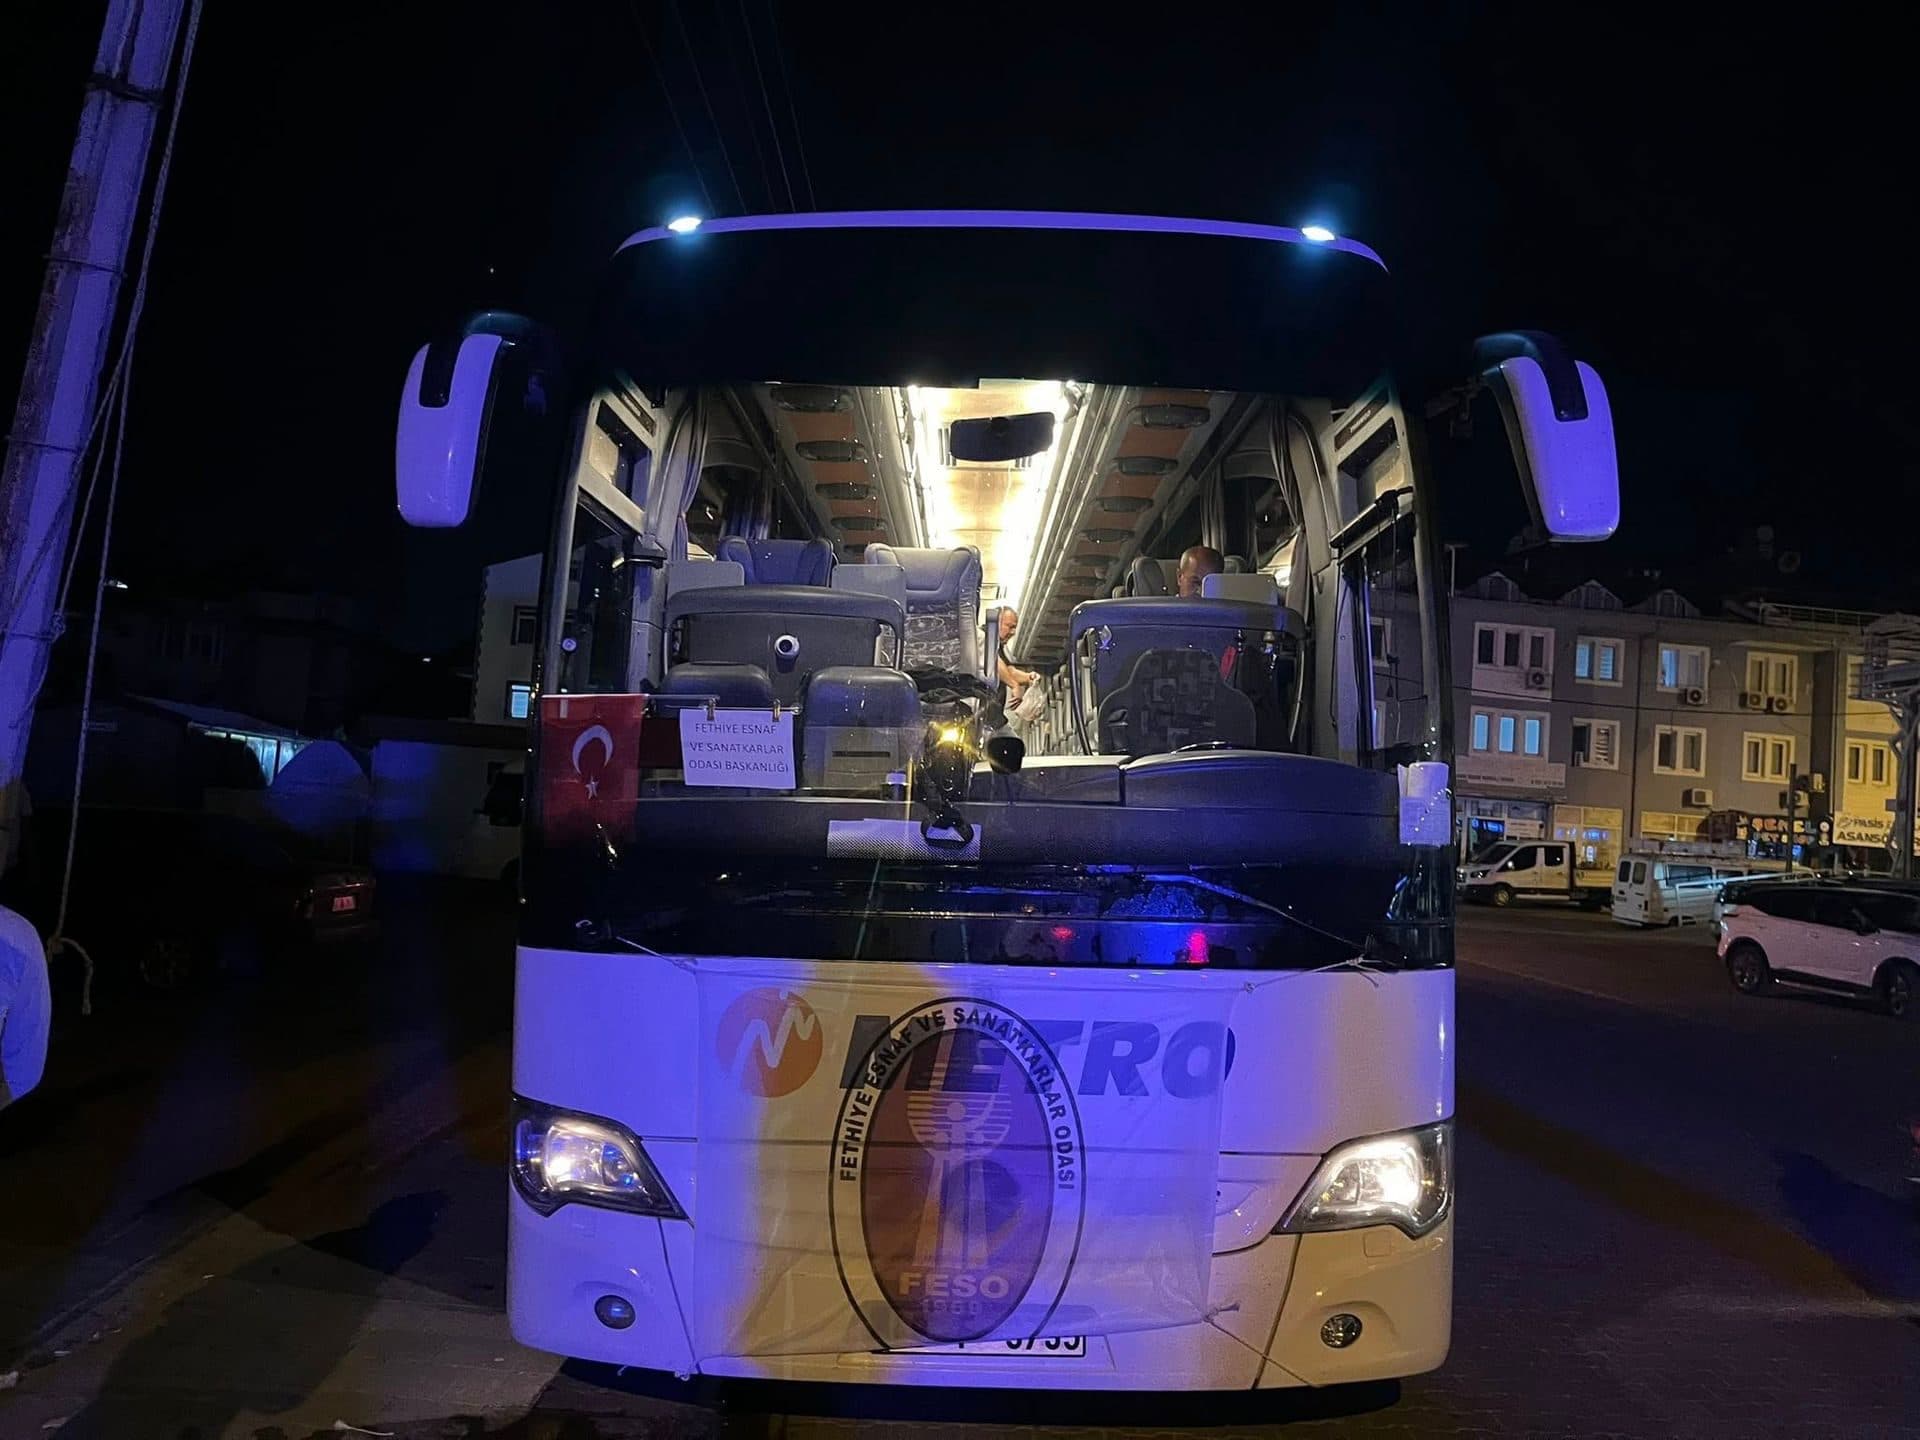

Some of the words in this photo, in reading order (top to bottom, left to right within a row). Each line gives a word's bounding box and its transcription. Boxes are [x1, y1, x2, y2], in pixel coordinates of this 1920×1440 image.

[741, 723, 777, 735] ESNAF
[689, 742, 704, 752] VE
[706, 742, 784, 754] SANATKARLAR
[688, 759, 722, 770] ODASI
[840, 1091, 873, 1182] FETHİYE
[865, 1026, 914, 1087] ESNAF
[916, 1009, 945, 1032] VE
[1054, 1125, 1075, 1190] ODASI
[899, 1272, 1010, 1299] FESO
